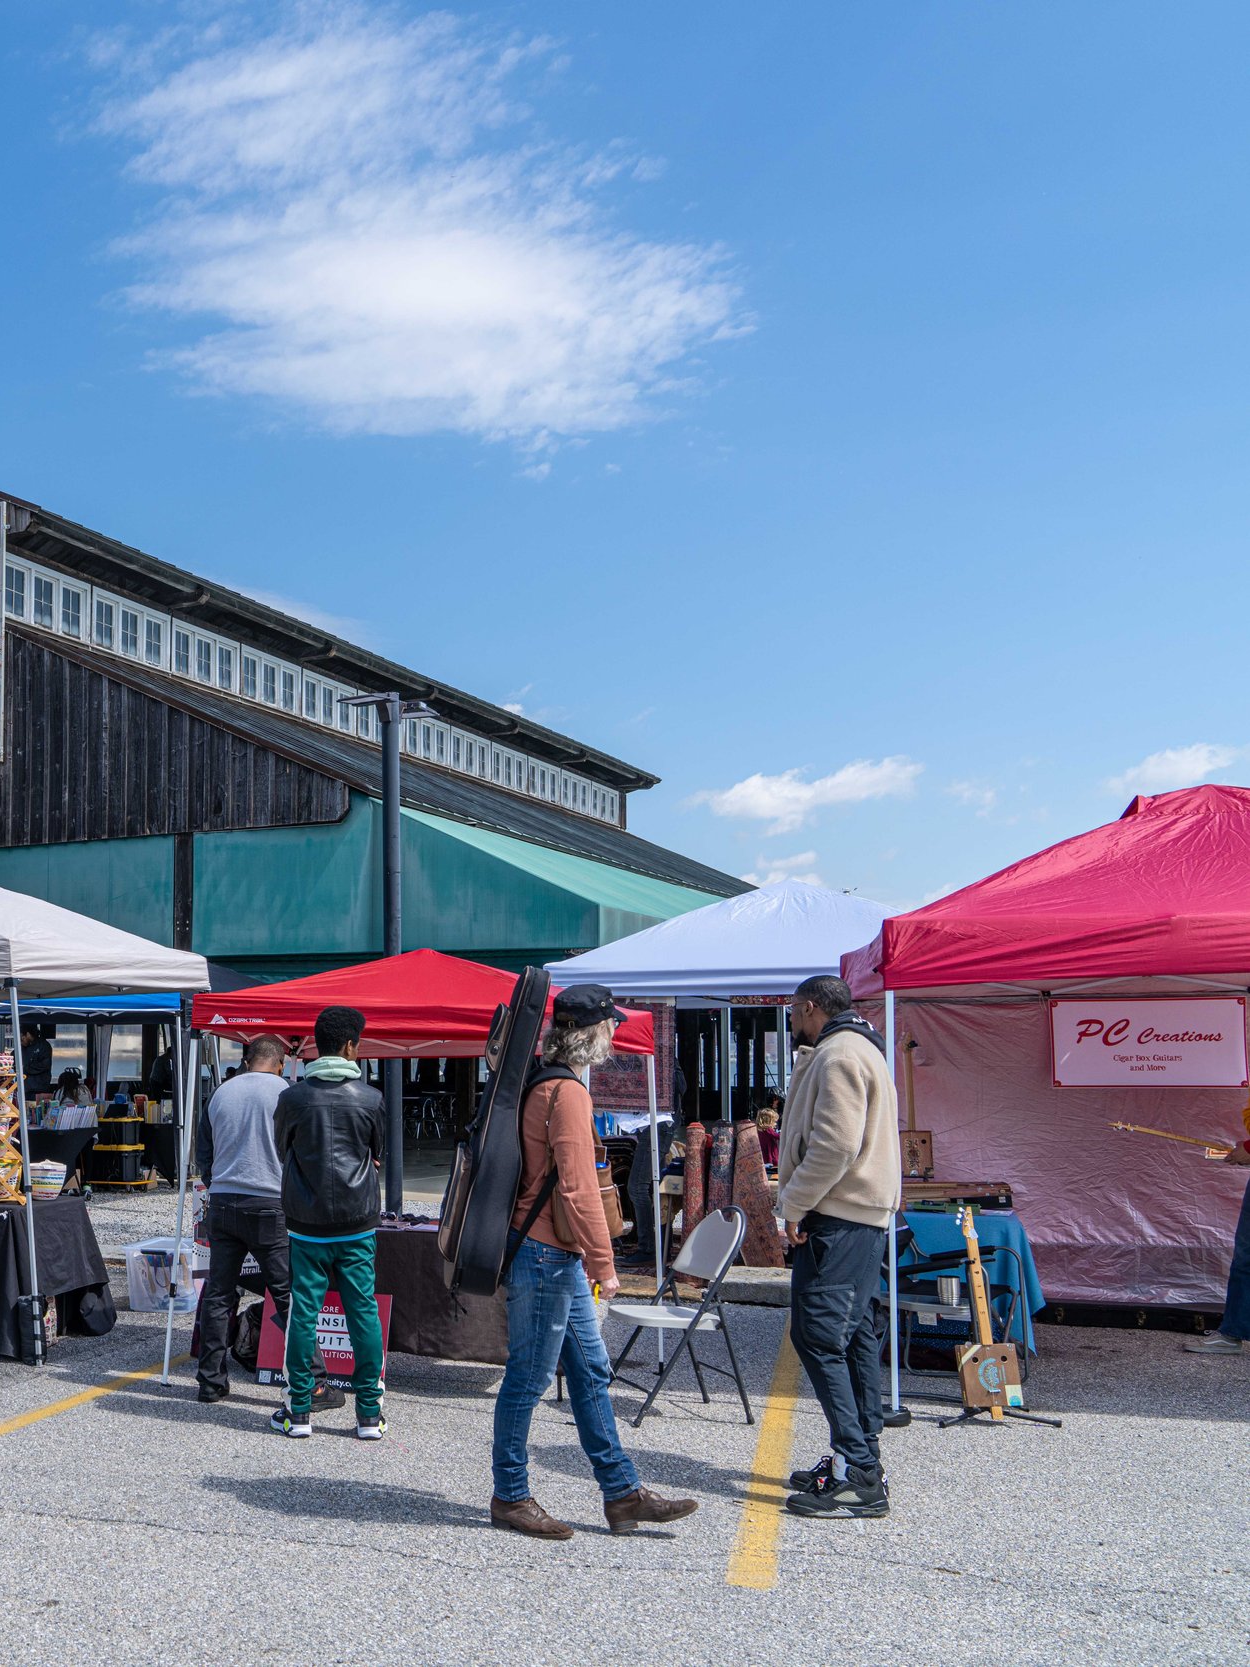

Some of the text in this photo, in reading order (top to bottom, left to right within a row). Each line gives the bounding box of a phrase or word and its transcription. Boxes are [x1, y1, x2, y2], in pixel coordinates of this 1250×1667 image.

[1075, 1018, 1223, 1047] PC Creations
[1113, 1054, 1183, 1063] Cigar Box Guitars
[240, 1265, 262, 1276] htrail.
[320, 1305, 339, 1313] ORE
[317, 1317, 344, 1327] NSI
[317, 1335, 352, 1346] UIT
